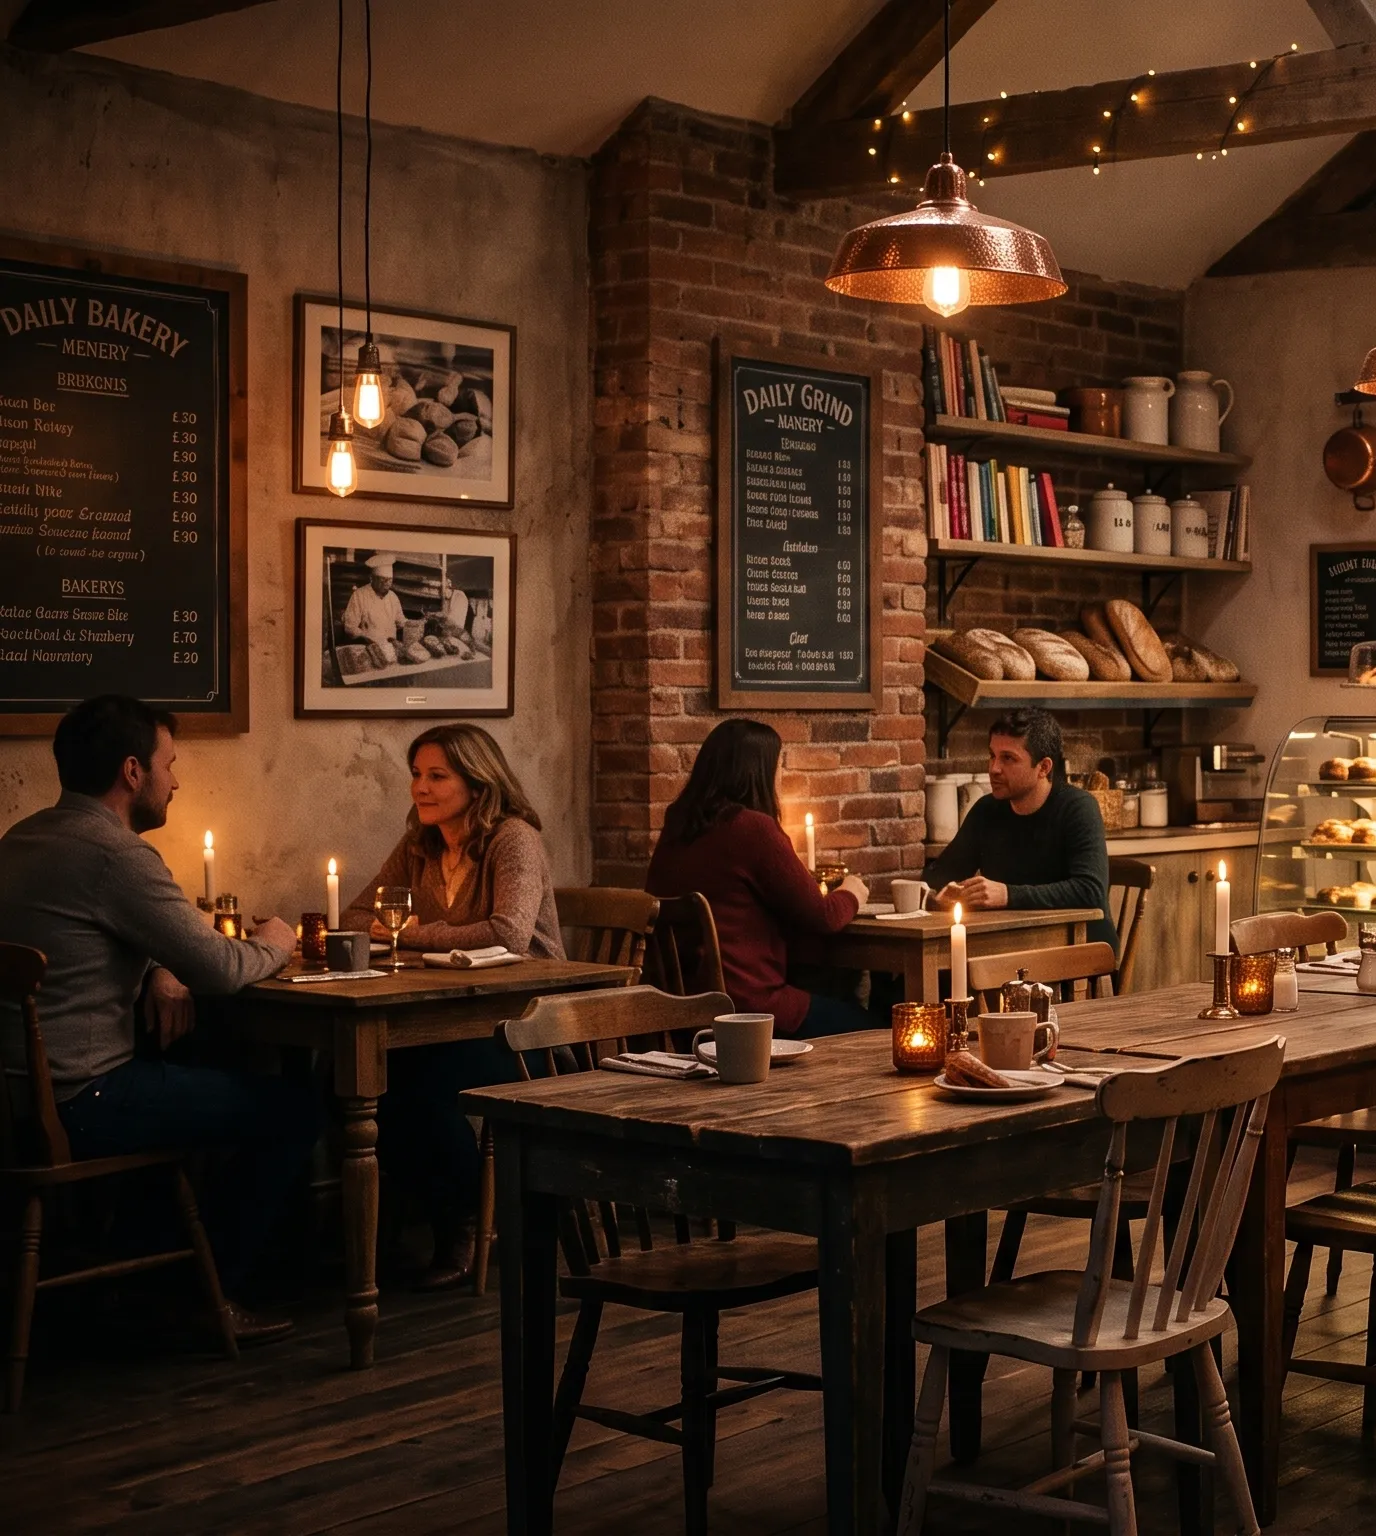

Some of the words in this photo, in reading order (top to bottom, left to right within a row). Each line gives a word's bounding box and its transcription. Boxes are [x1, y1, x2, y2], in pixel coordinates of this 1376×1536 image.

[0, 297, 78, 336] DAILY
[87, 298, 190, 359] BAKERY
[61, 338, 130, 362] MENERY
[743, 383, 796, 416] DAILY
[800, 383, 853, 427] GRIND
[778, 414, 824, 433] MANERY
[61, 578, 125, 595] BAKERYS
